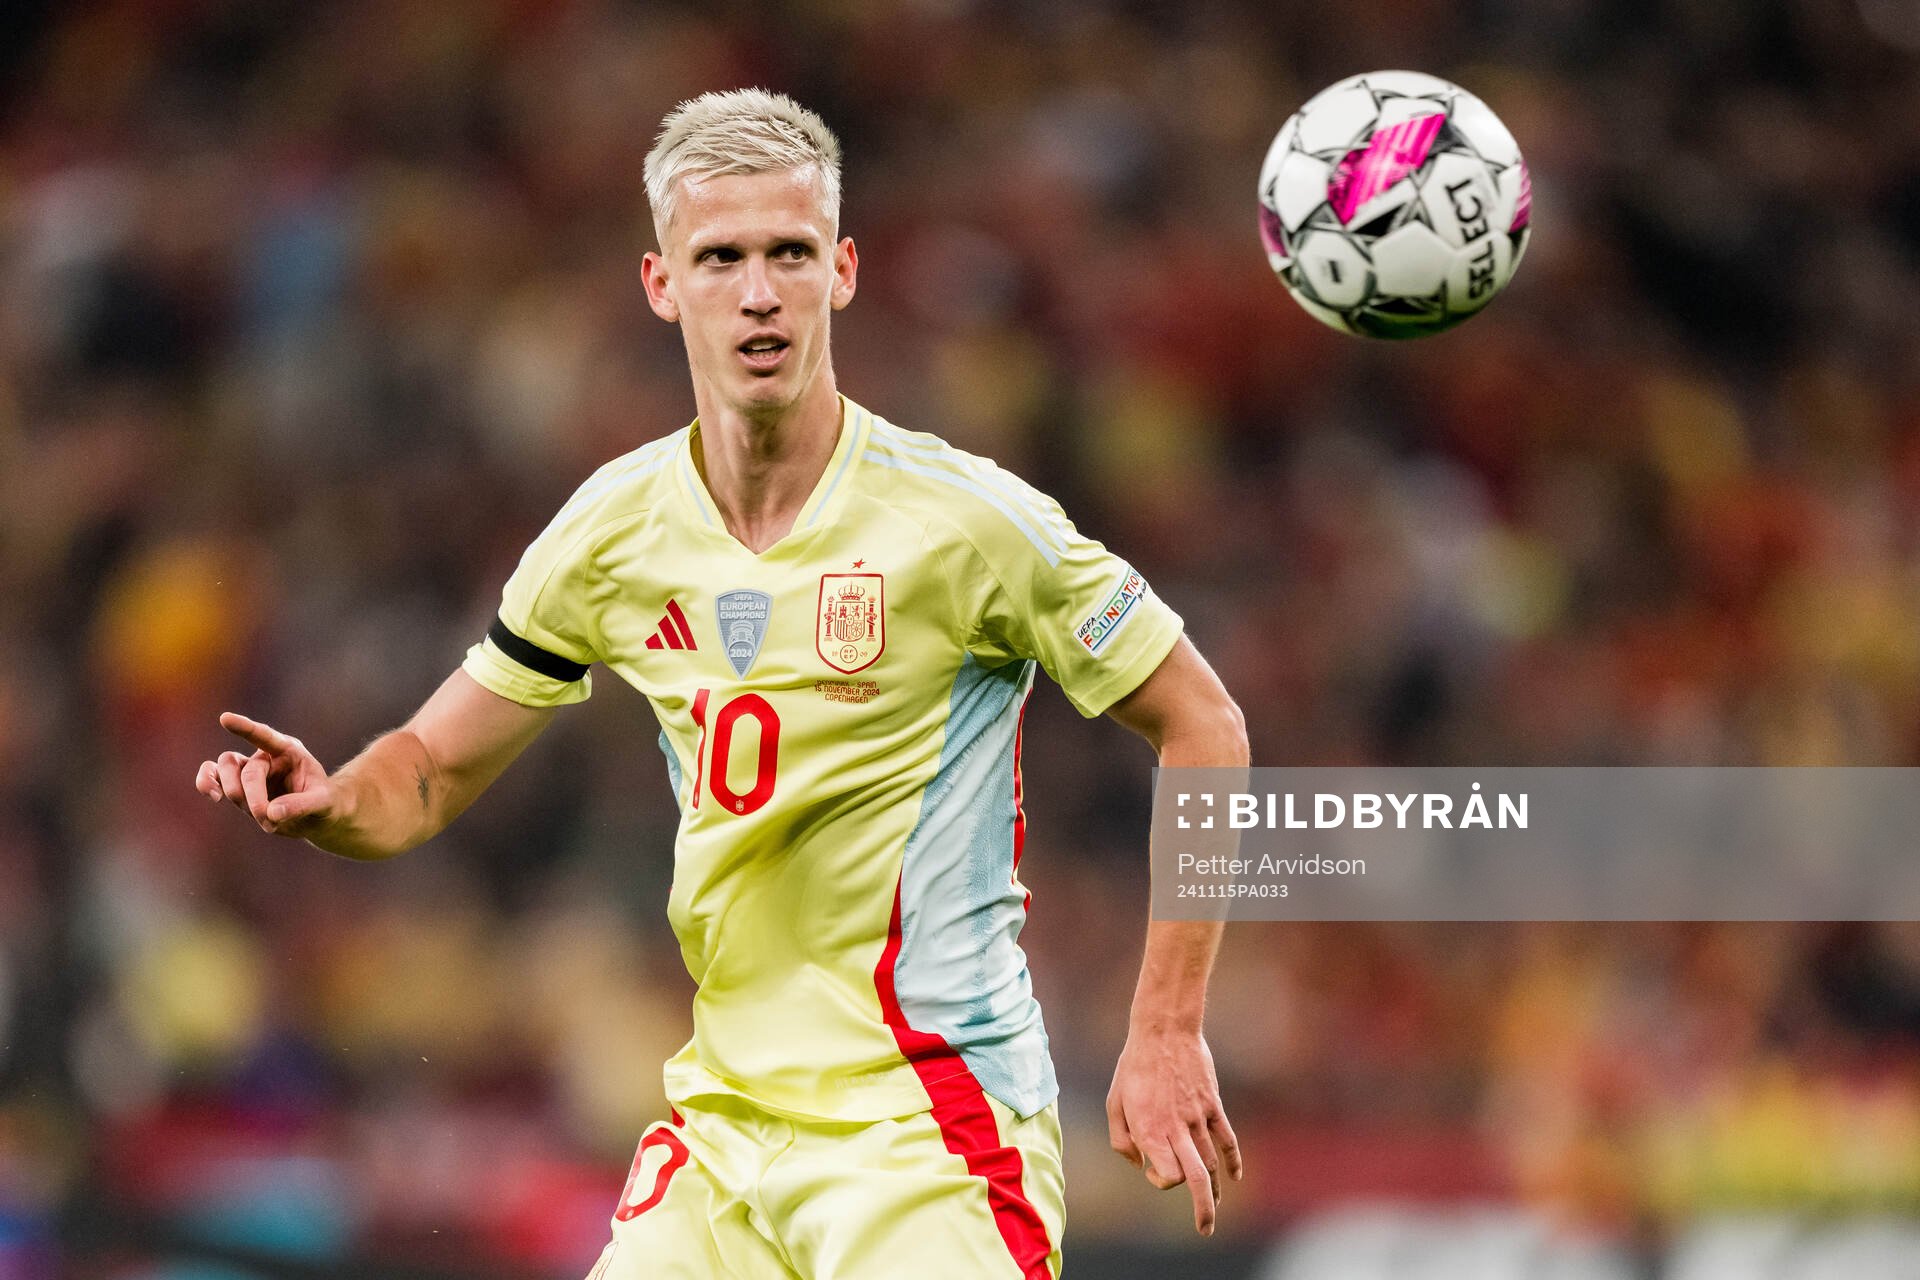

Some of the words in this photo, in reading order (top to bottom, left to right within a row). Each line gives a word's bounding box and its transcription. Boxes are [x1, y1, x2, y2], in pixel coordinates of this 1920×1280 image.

[1444, 178, 1495, 299] SELECT
[720, 601, 766, 610] EUROPEAN
[720, 610, 766, 619] CHAMPIONS
[1077, 616, 1097, 638] UEFA
[730, 649, 753, 658] 2024
[824, 686, 860, 695] NOVEMBER
[825, 693, 869, 703] COPENHAGEN
[690, 688, 781, 816] 10
